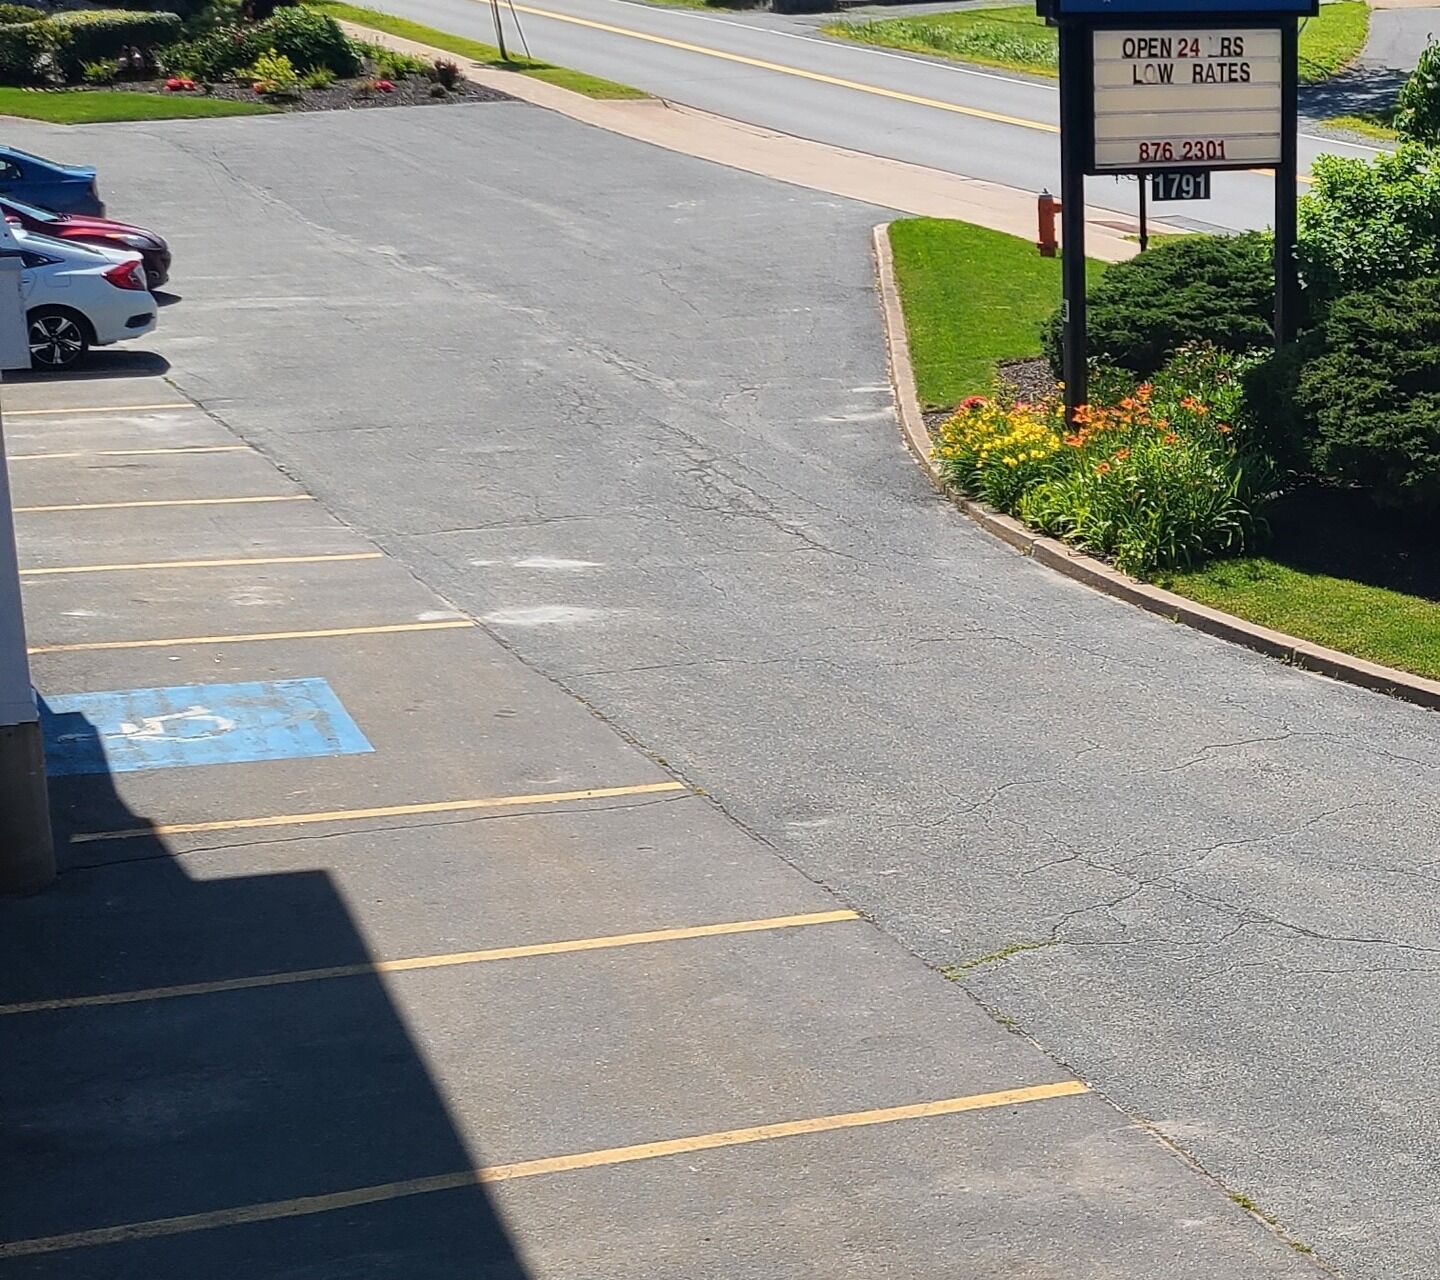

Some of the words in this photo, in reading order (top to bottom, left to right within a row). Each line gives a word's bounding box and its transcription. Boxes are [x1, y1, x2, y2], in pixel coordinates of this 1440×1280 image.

[1122, 37, 1172, 58] OPEN
[1177, 37, 1200, 58] 24
[1208, 36, 1244, 57] RS
[1133, 63, 1174, 84] LOW
[1192, 62, 1250, 83] RATES
[1139, 142, 1173, 161] 876
[1182, 140, 1226, 160] 2301
[1154, 173, 1206, 199] 1791
